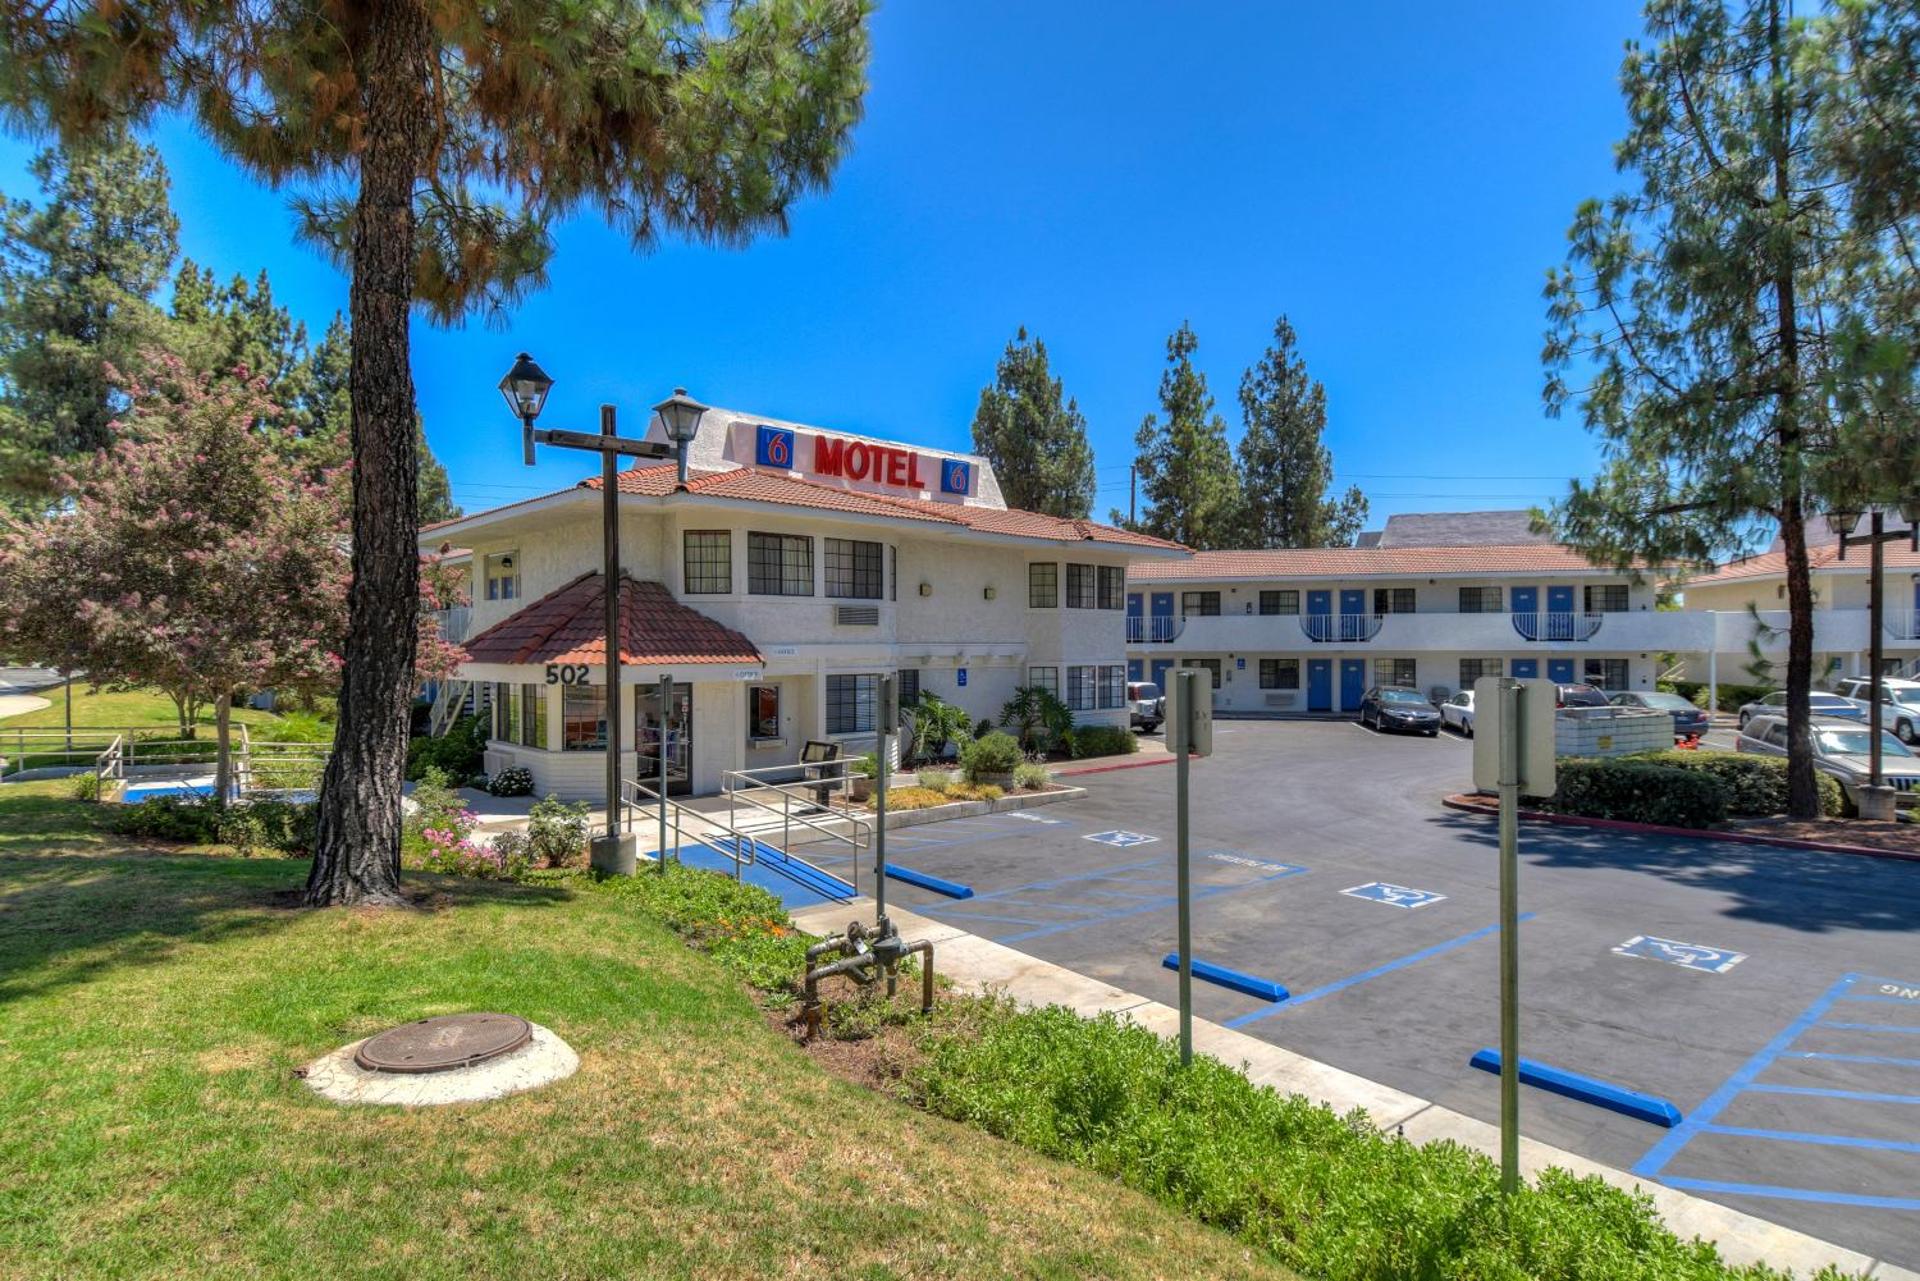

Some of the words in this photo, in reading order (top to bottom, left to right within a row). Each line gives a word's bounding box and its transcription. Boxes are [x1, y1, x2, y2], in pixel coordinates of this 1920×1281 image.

[768, 433, 788, 465] 6
[815, 435, 925, 489] MOTEL
[951, 464, 966, 491] 6
[546, 664, 590, 685] 502
